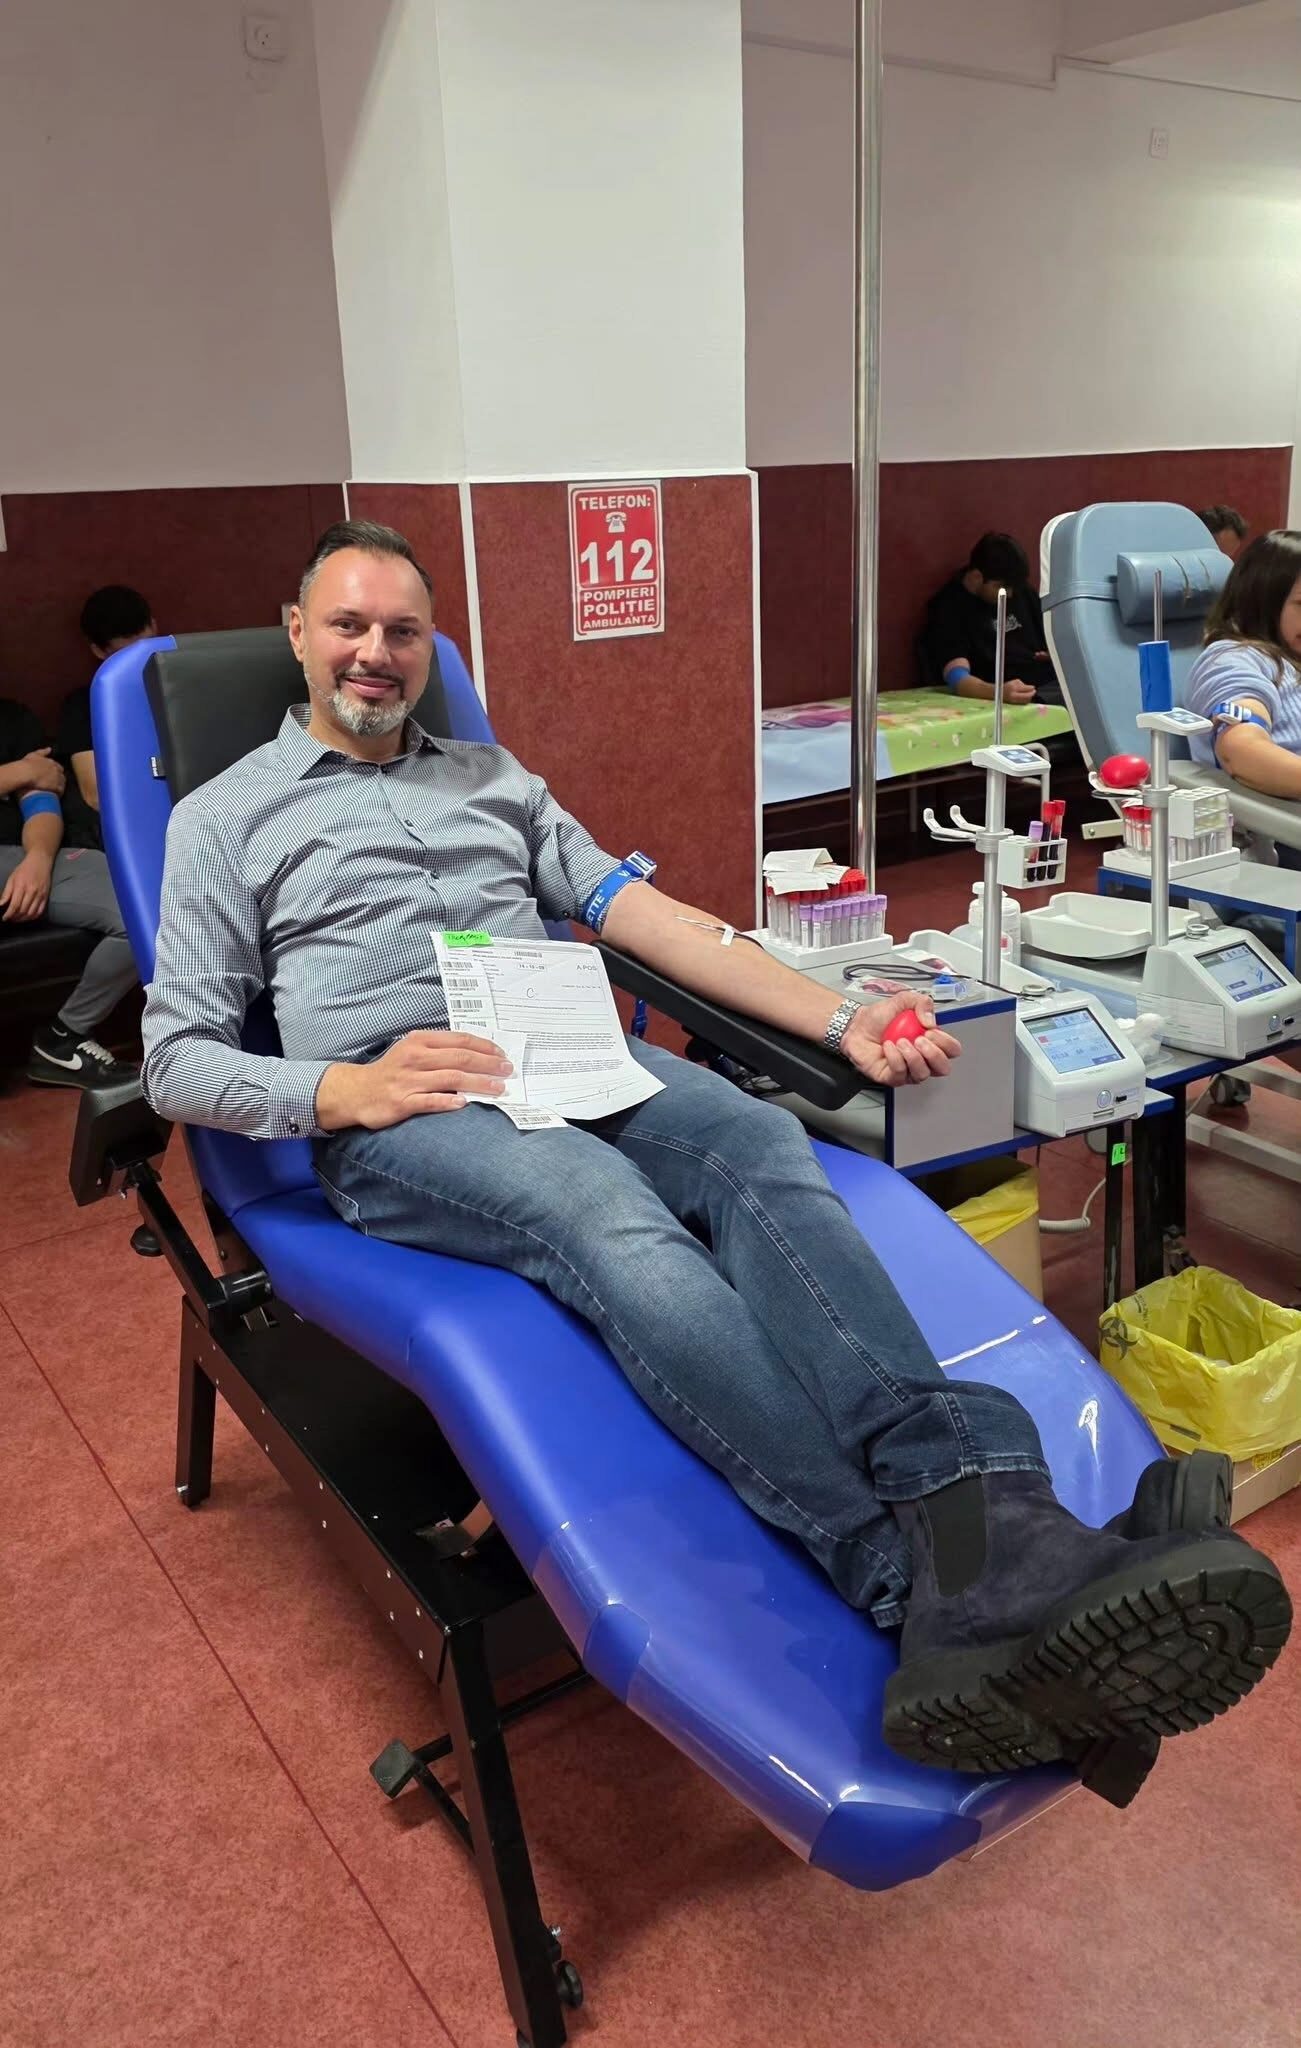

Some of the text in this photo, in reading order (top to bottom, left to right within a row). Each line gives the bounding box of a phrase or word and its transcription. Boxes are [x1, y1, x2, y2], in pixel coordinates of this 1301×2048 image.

[579, 494, 651, 511] TELEFON:
[580, 538, 655, 585] 112
[583, 586, 655, 602] POMPIERI
